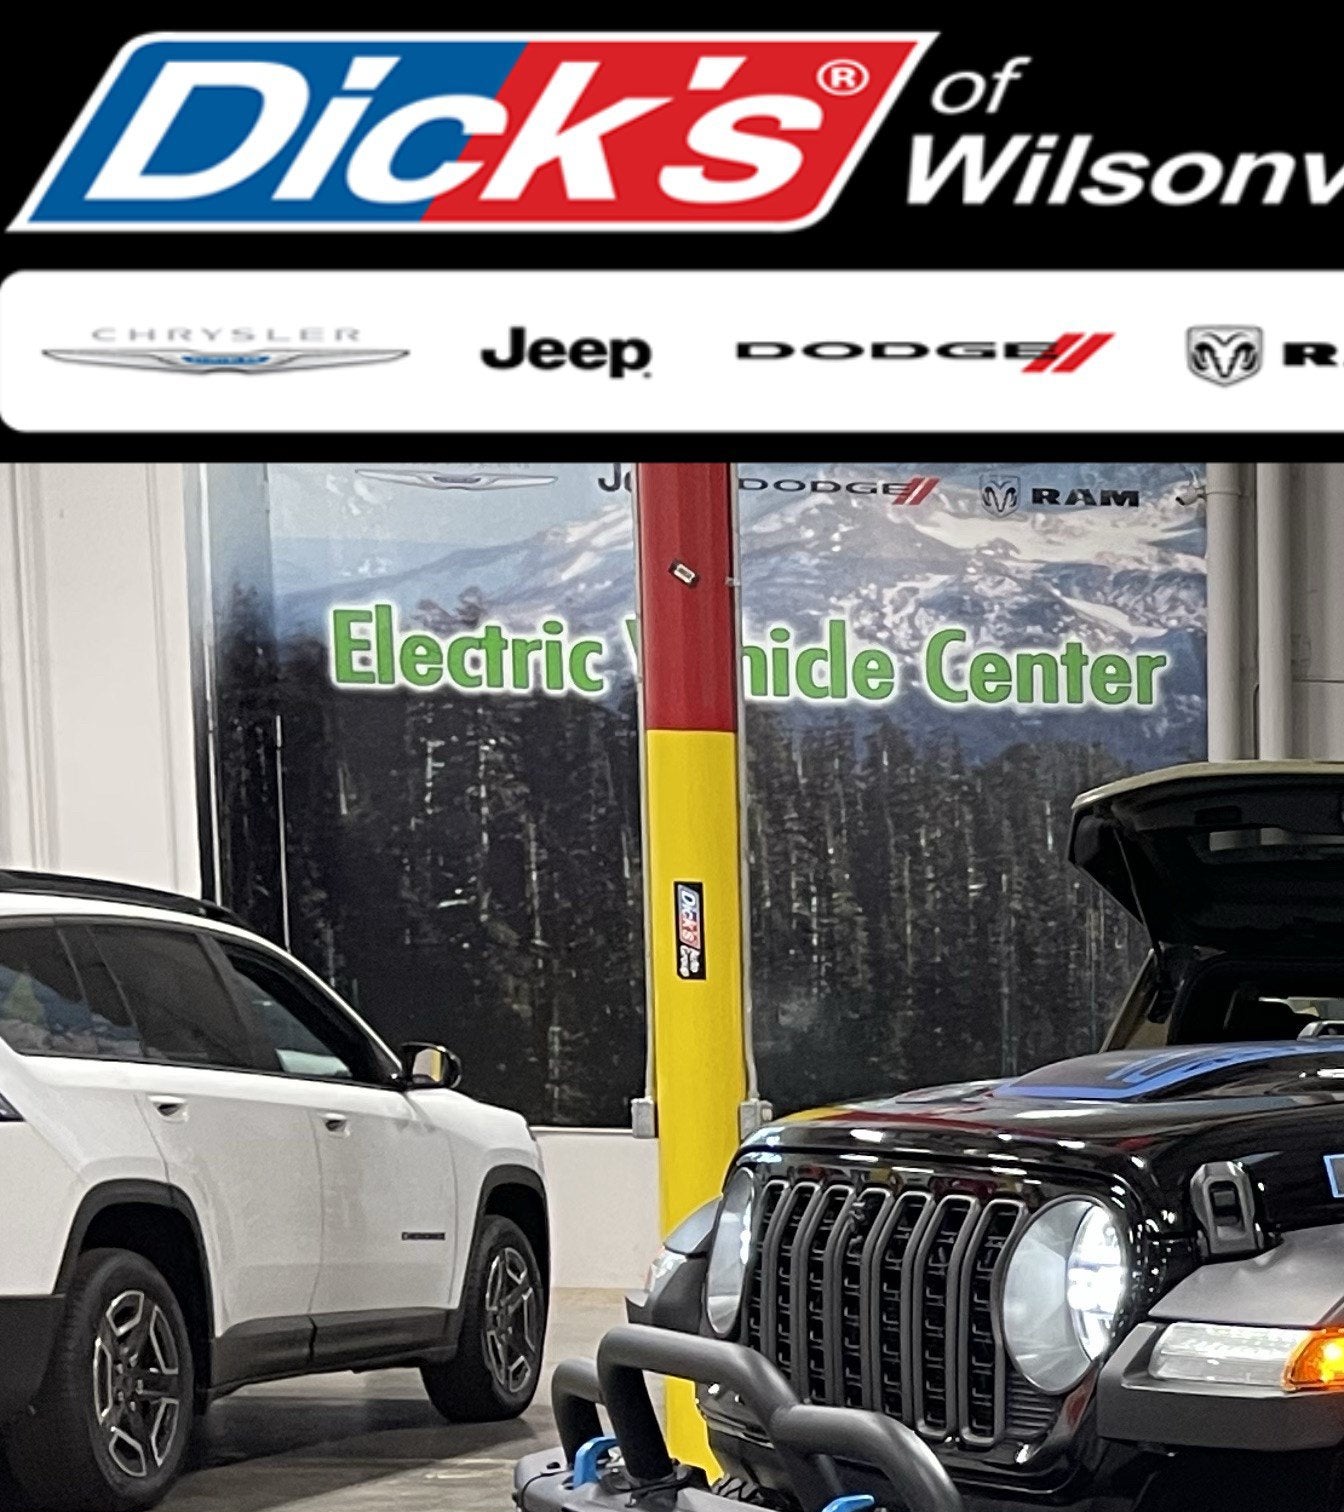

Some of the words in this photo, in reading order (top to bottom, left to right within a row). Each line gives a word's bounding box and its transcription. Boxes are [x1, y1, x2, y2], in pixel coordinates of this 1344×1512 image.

[738, 477, 911, 496] DODGE
[1031, 487, 1140, 508] RAM
[333, 604, 604, 692] Electric
[926, 629, 1167, 704] Center
